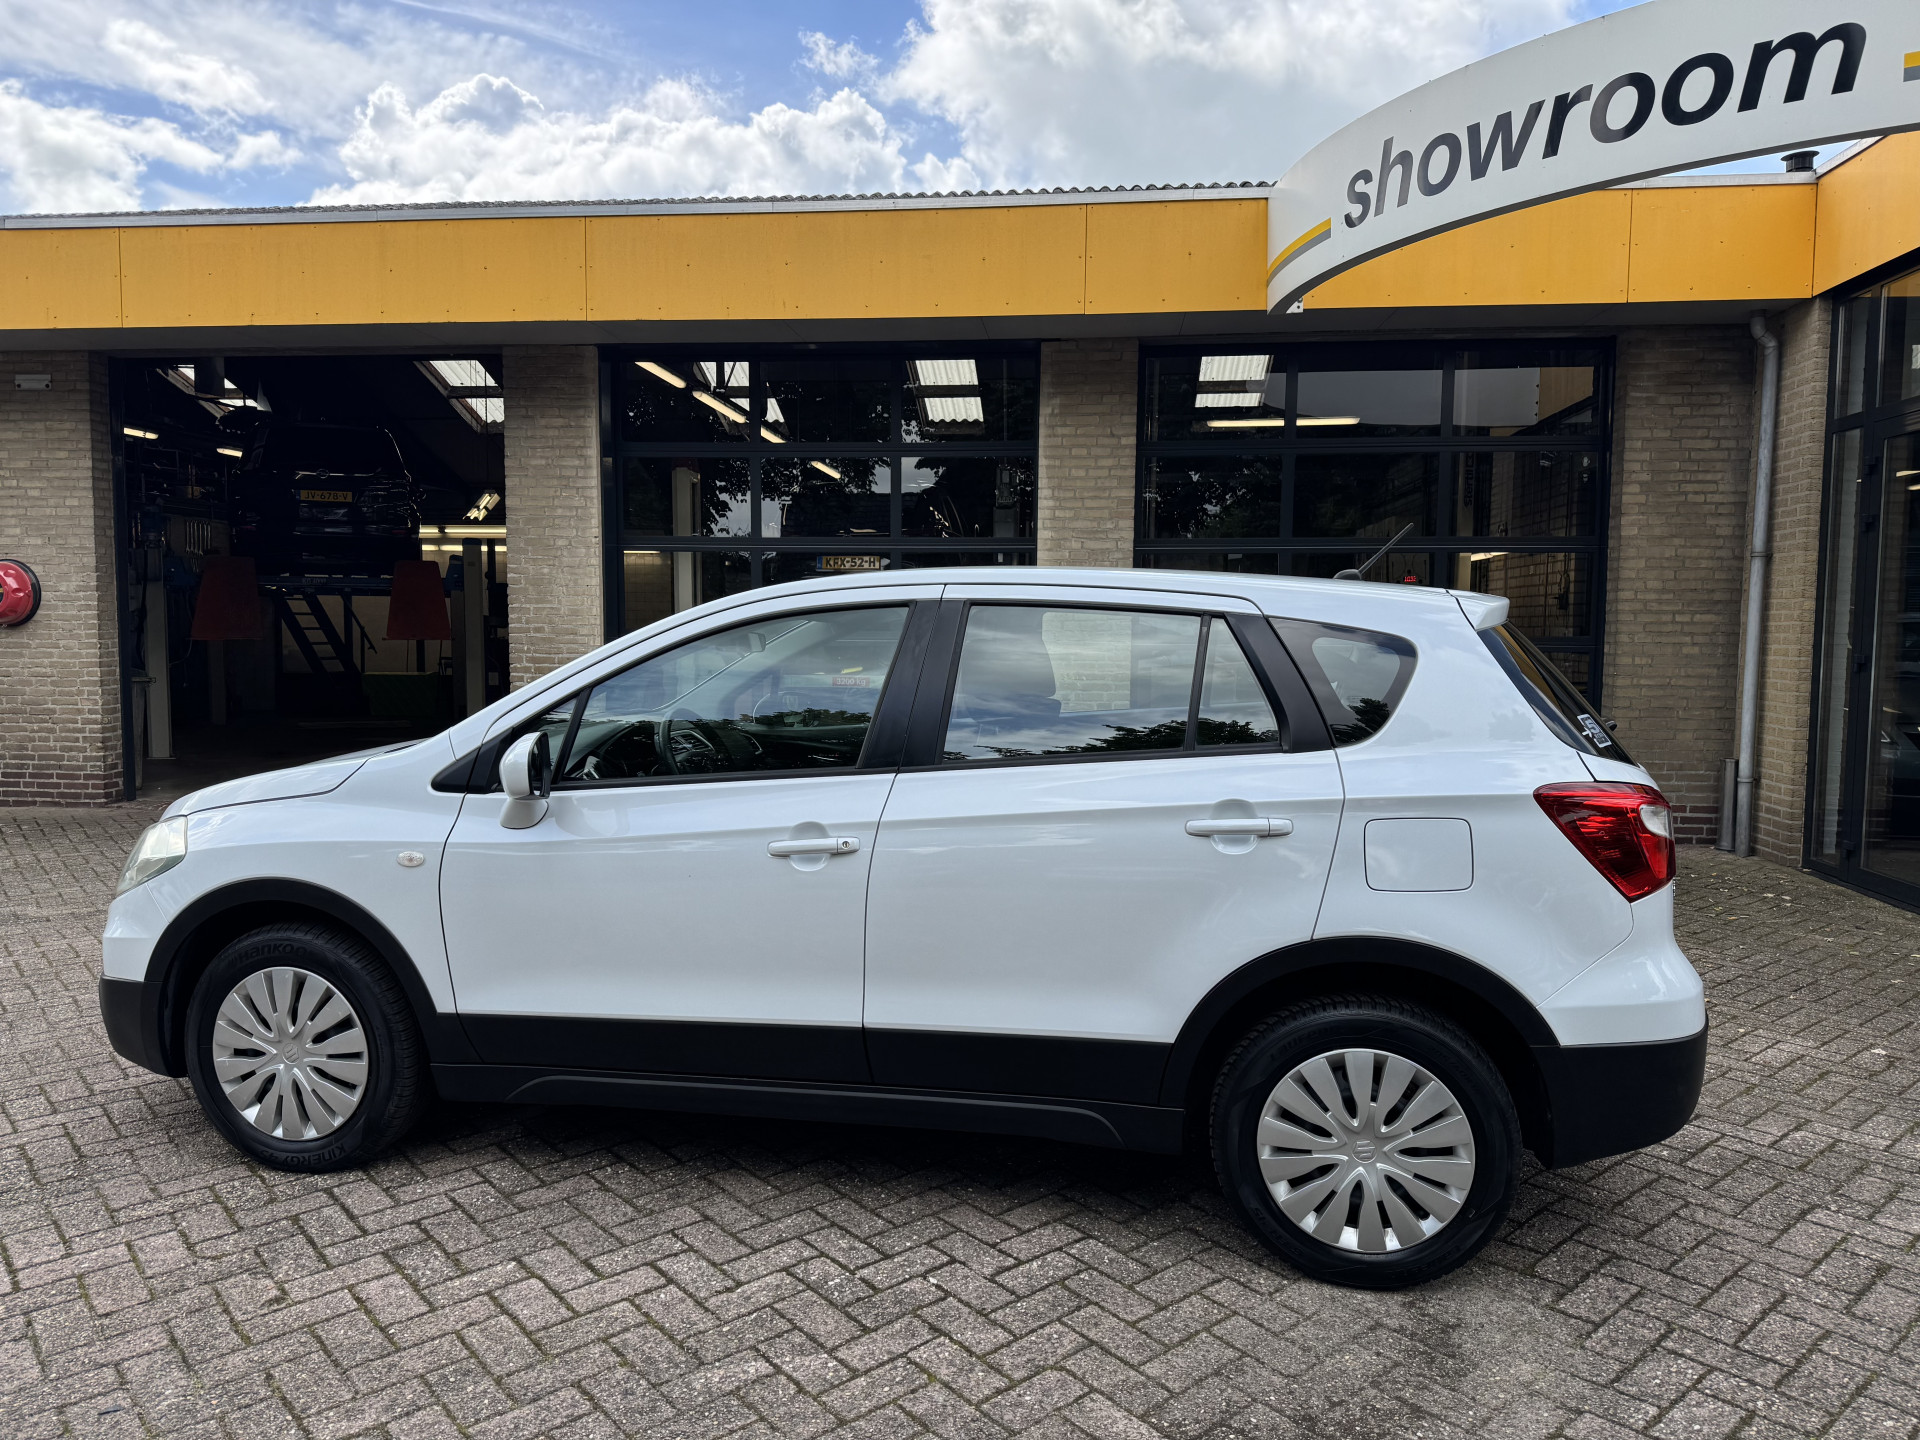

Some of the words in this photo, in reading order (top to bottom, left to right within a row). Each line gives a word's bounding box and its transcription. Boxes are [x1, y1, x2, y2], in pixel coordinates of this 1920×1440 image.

[1343, 22, 1867, 229] showroom
[825, 556, 876, 568] KFX-52-H
[836, 677, 855, 685] 3200
